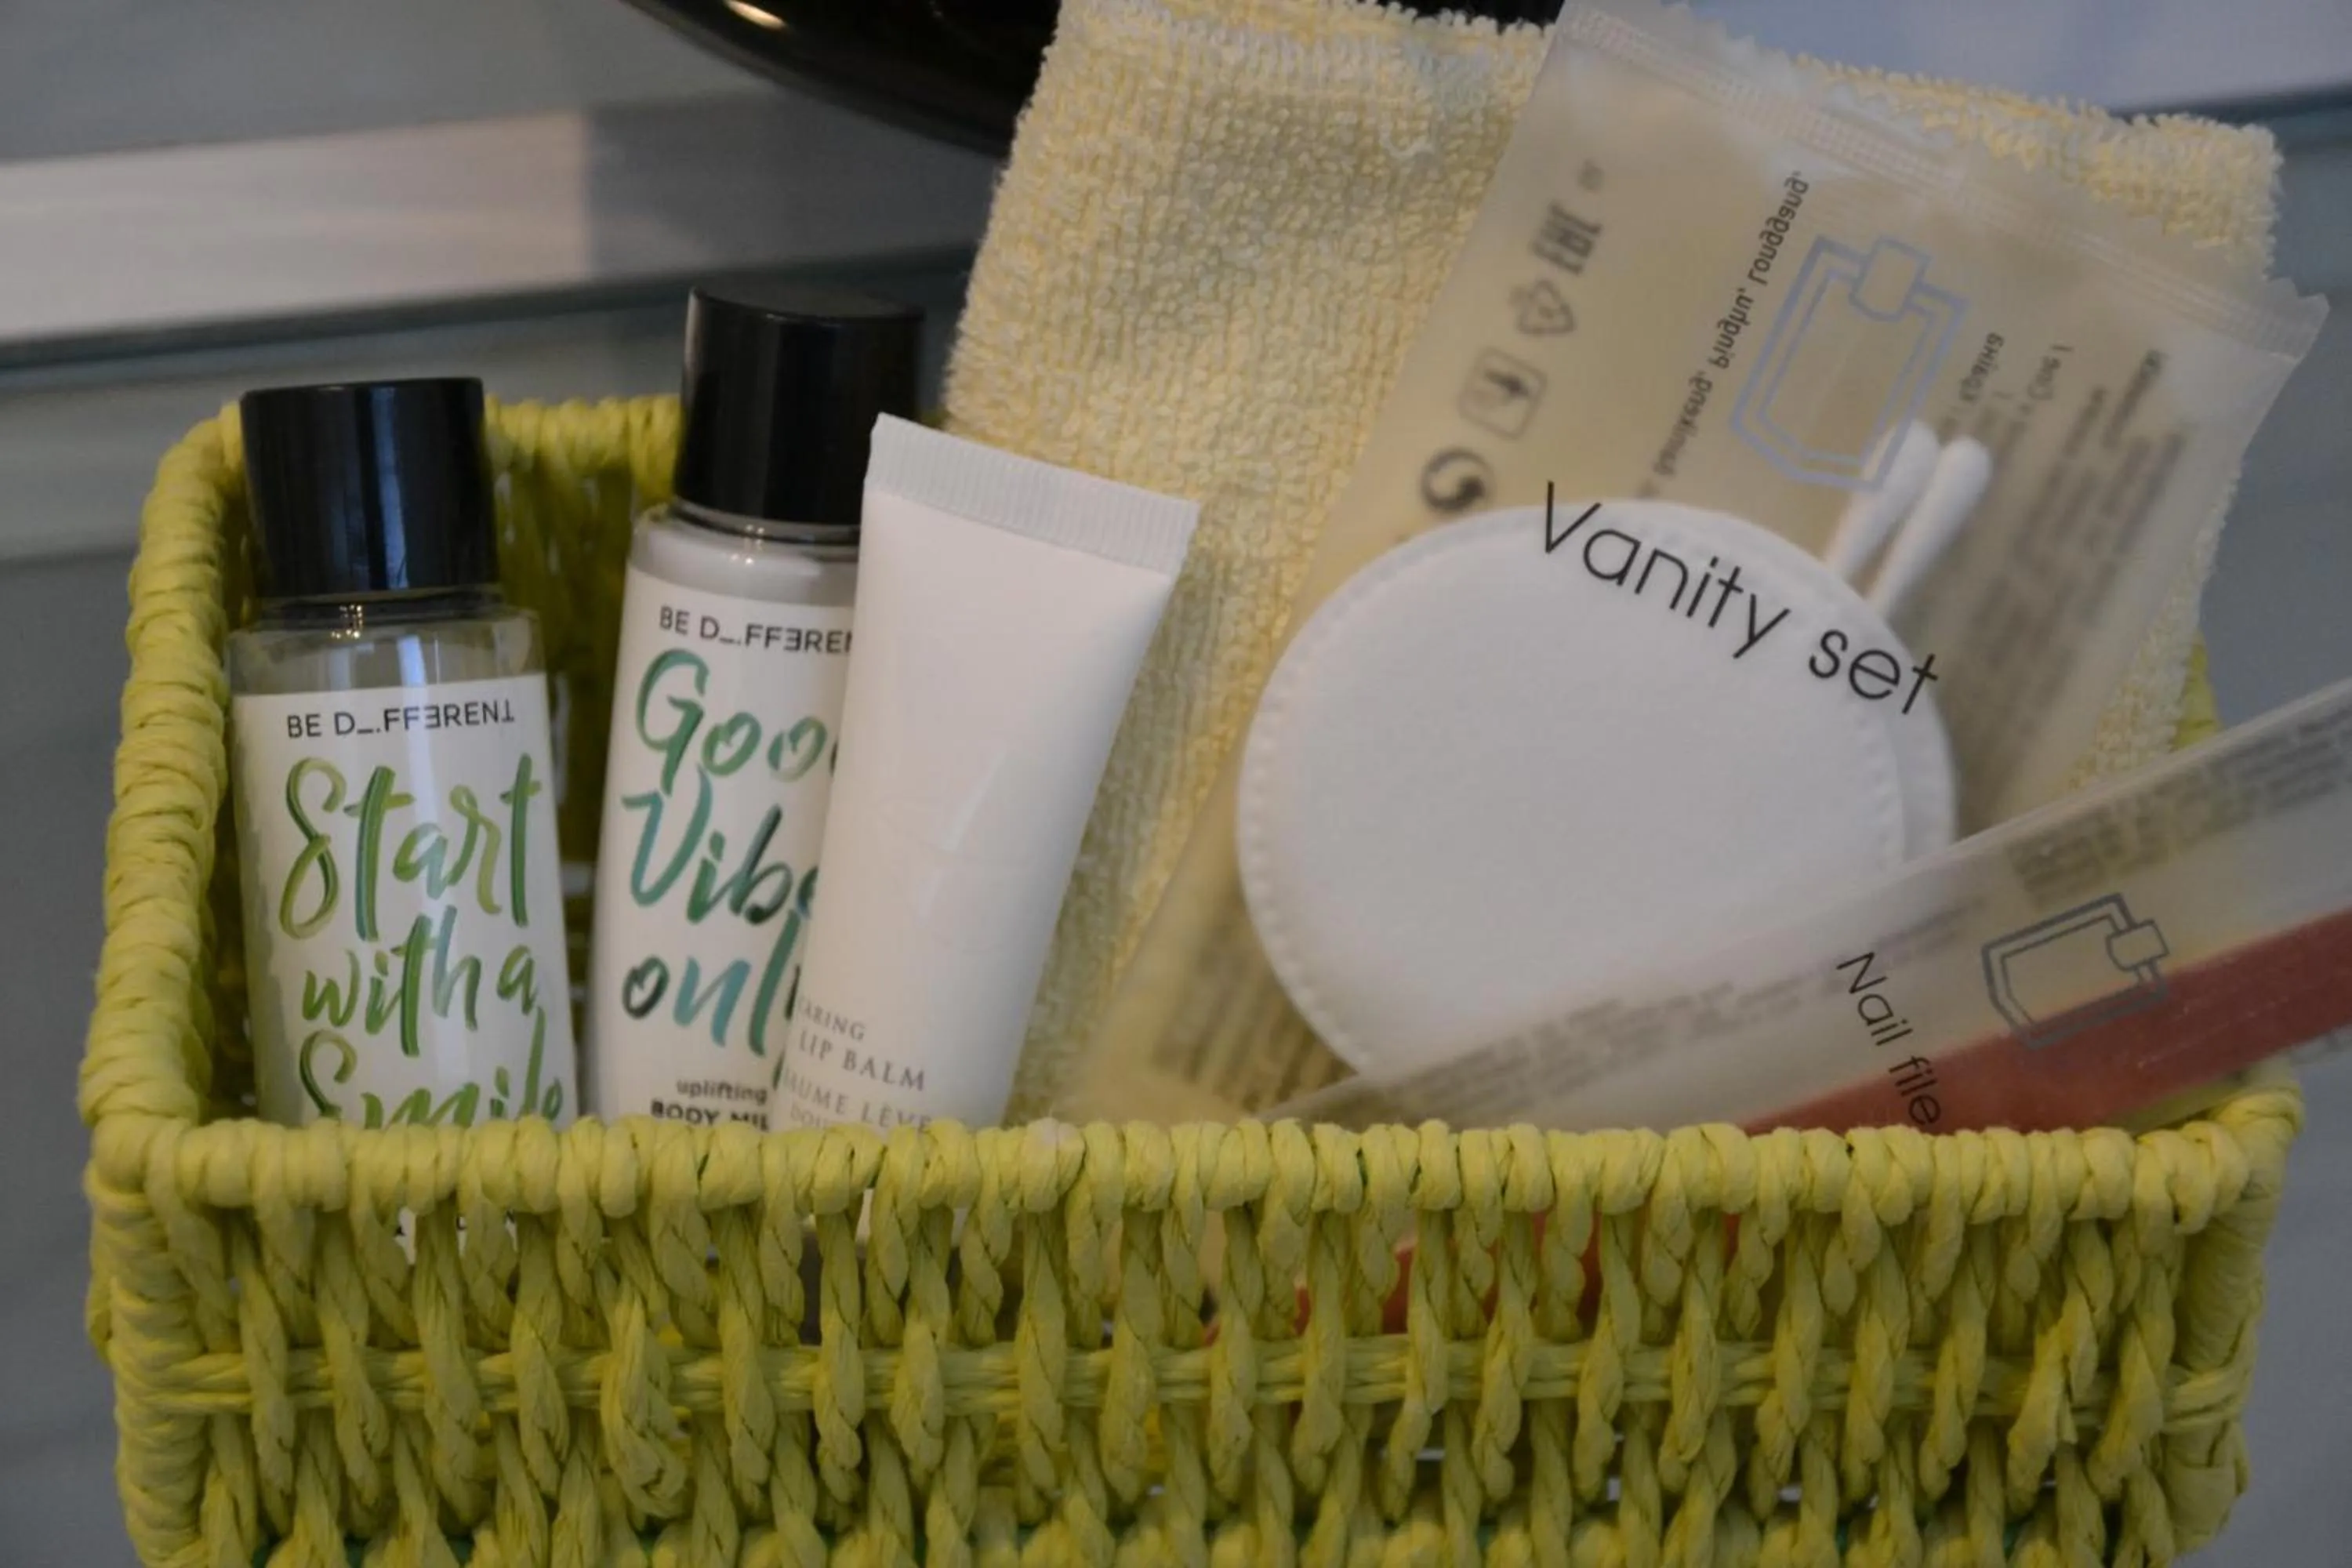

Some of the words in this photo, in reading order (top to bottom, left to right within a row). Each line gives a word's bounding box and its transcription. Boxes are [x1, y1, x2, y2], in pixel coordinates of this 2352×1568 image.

[659, 605, 691, 636] BE
[1544, 481, 1791, 658] Vanity
[1809, 630, 1939, 714] set
[287, 713, 322, 739] BE
[636, 648, 838, 796] Goo
[279, 753, 542, 941] Start
[622, 908, 801, 1091] onl
[1836, 952, 1914, 1046] Nail
[1888, 1055, 1941, 1126] file
[677, 1079, 768, 1106] uplifting
[800, 1026, 833, 1061] LIP
[843, 1047, 925, 1091] BALM
[652, 1099, 720, 1127] BODY
